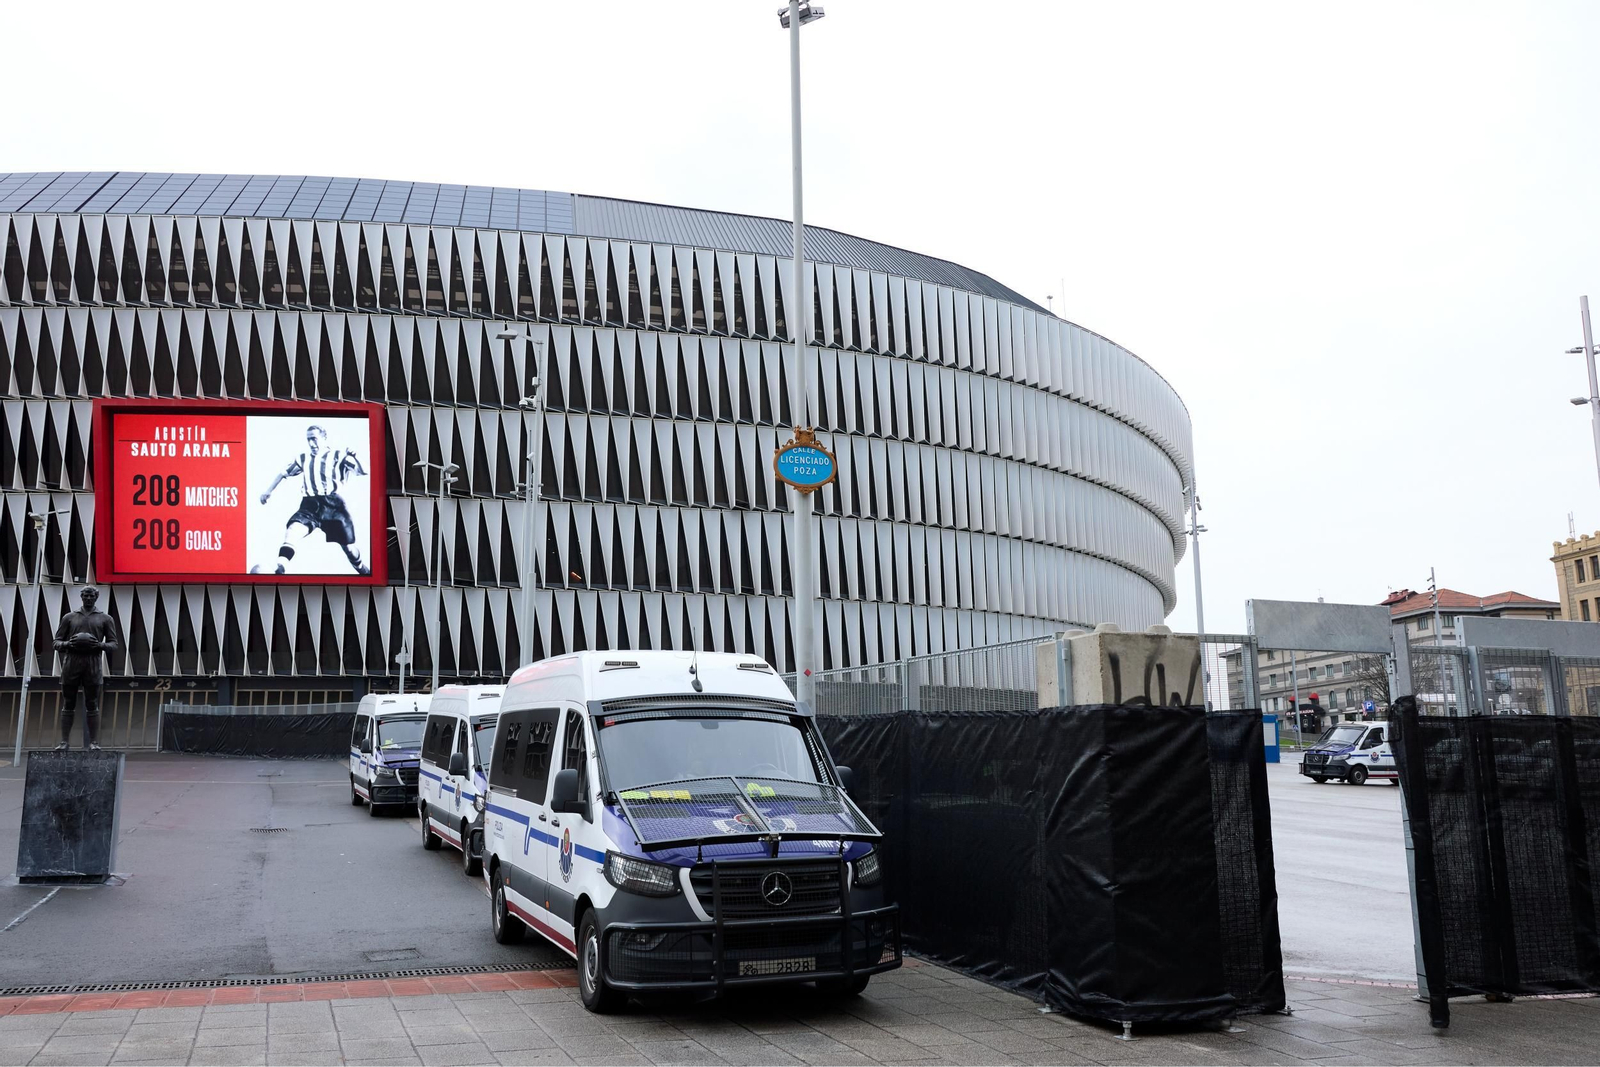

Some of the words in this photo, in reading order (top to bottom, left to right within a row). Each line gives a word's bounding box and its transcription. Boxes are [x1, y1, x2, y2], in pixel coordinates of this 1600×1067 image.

[154, 425, 206, 441] AGUSTÍN
[131, 442, 177, 457] SAUTO
[183, 443, 230, 457] ARANA
[792, 447, 816, 455] CALLE
[780, 455, 830, 466] LICENCIADO
[793, 466, 817, 475] POZA
[132, 474, 180, 506] 208
[185, 486, 238, 507] MATCHES
[132, 518, 180, 550] 208
[185, 530, 222, 551] GOALS
[154, 678, 172, 691] 23
